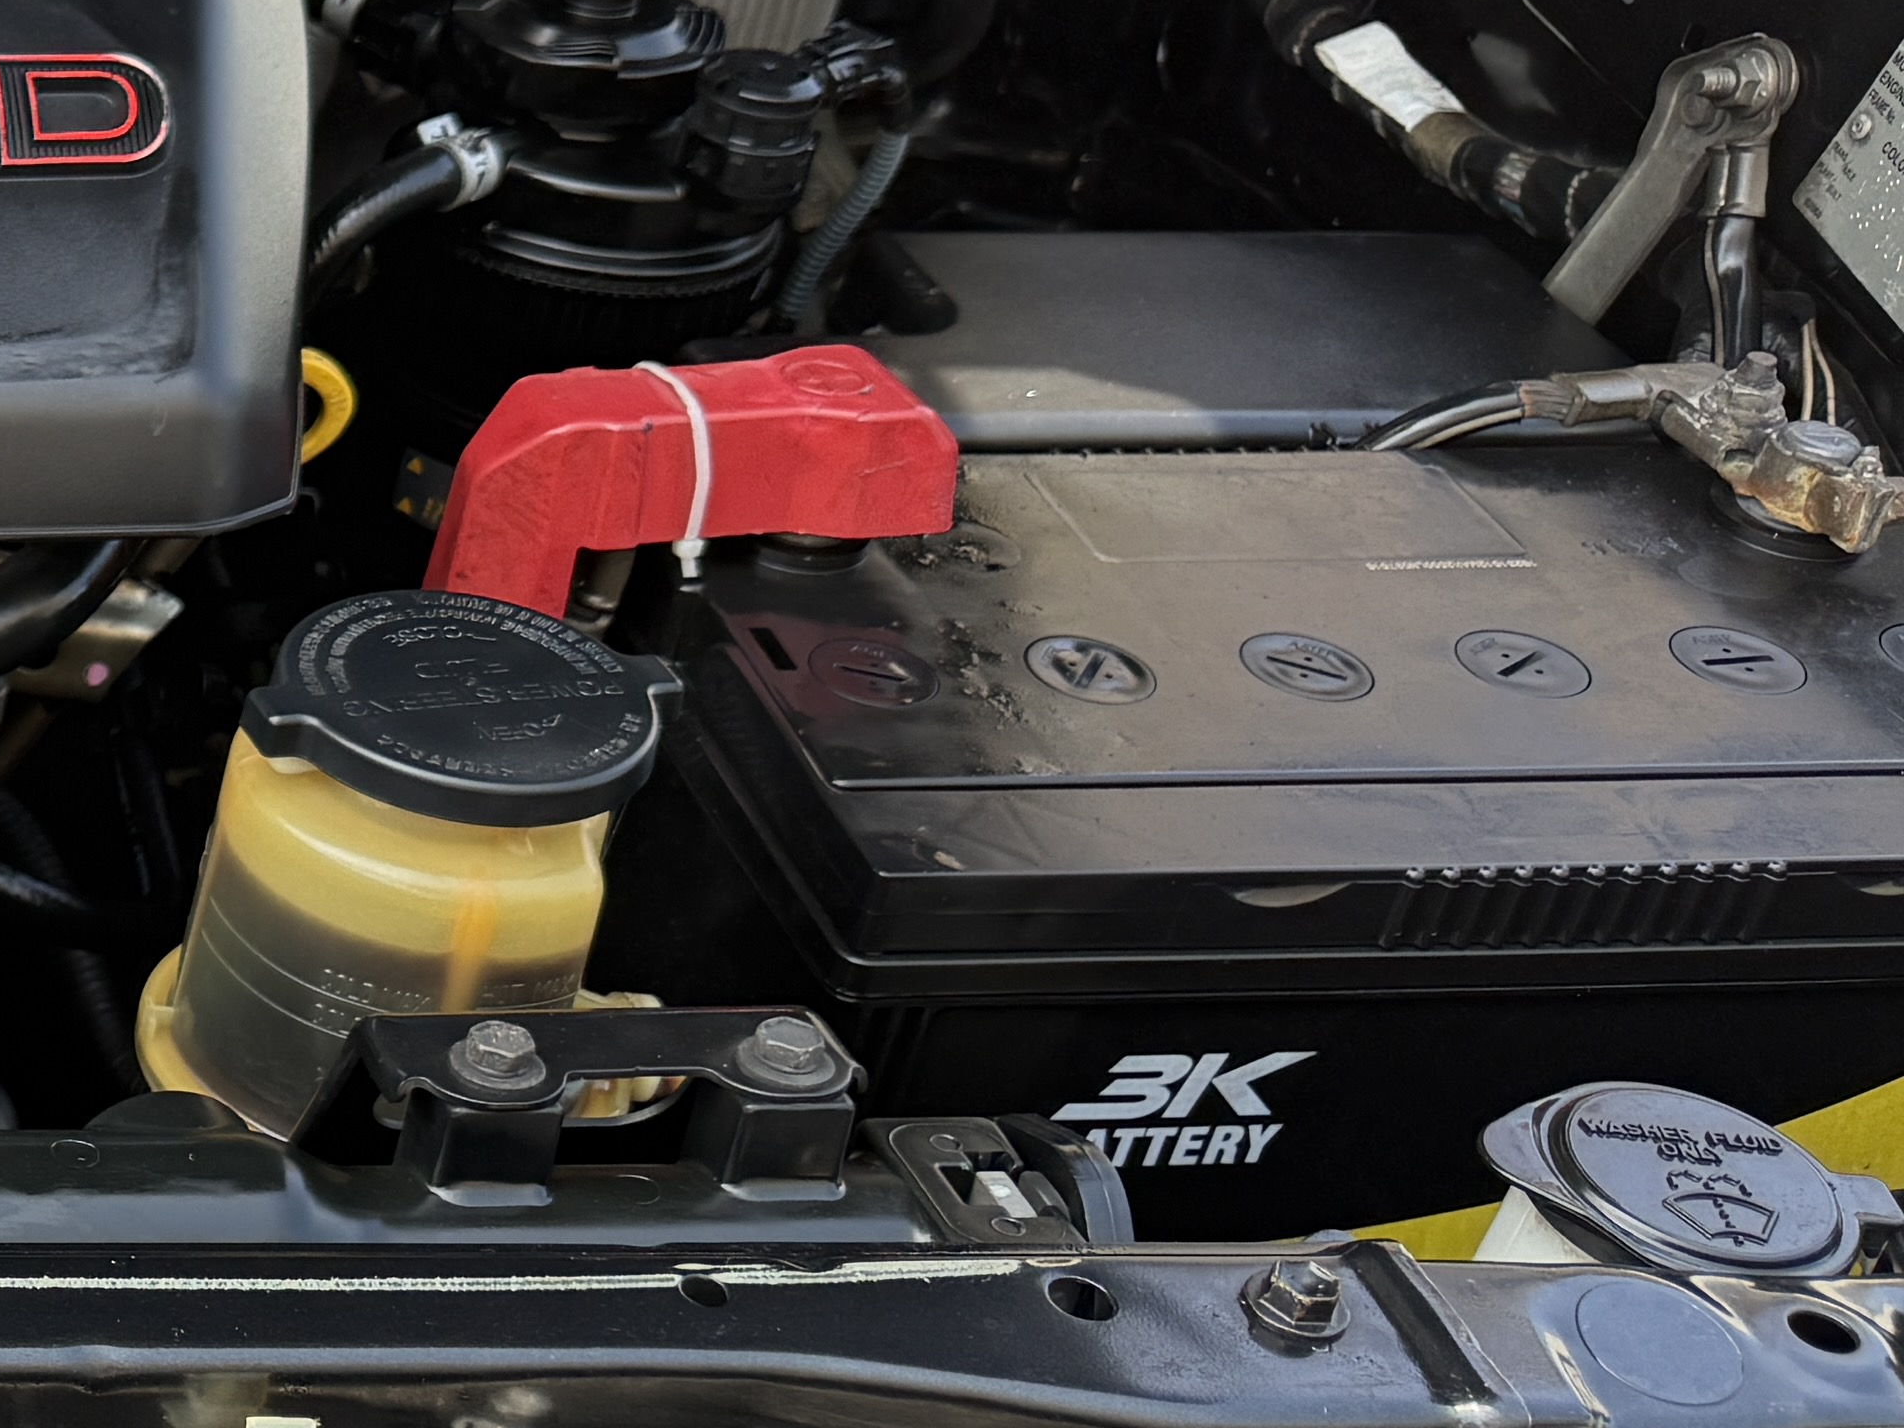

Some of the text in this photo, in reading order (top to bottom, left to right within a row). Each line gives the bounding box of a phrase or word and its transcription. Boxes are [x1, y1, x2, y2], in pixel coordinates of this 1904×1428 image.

[343, 679, 625, 717] POWER STEERING
[1049, 1051, 1318, 1121] 3K
[1084, 1123, 1284, 1167] ATTERY
[1578, 1117, 1784, 1155] WASHER FLUID
[1657, 1142, 1723, 1166] ONLY
